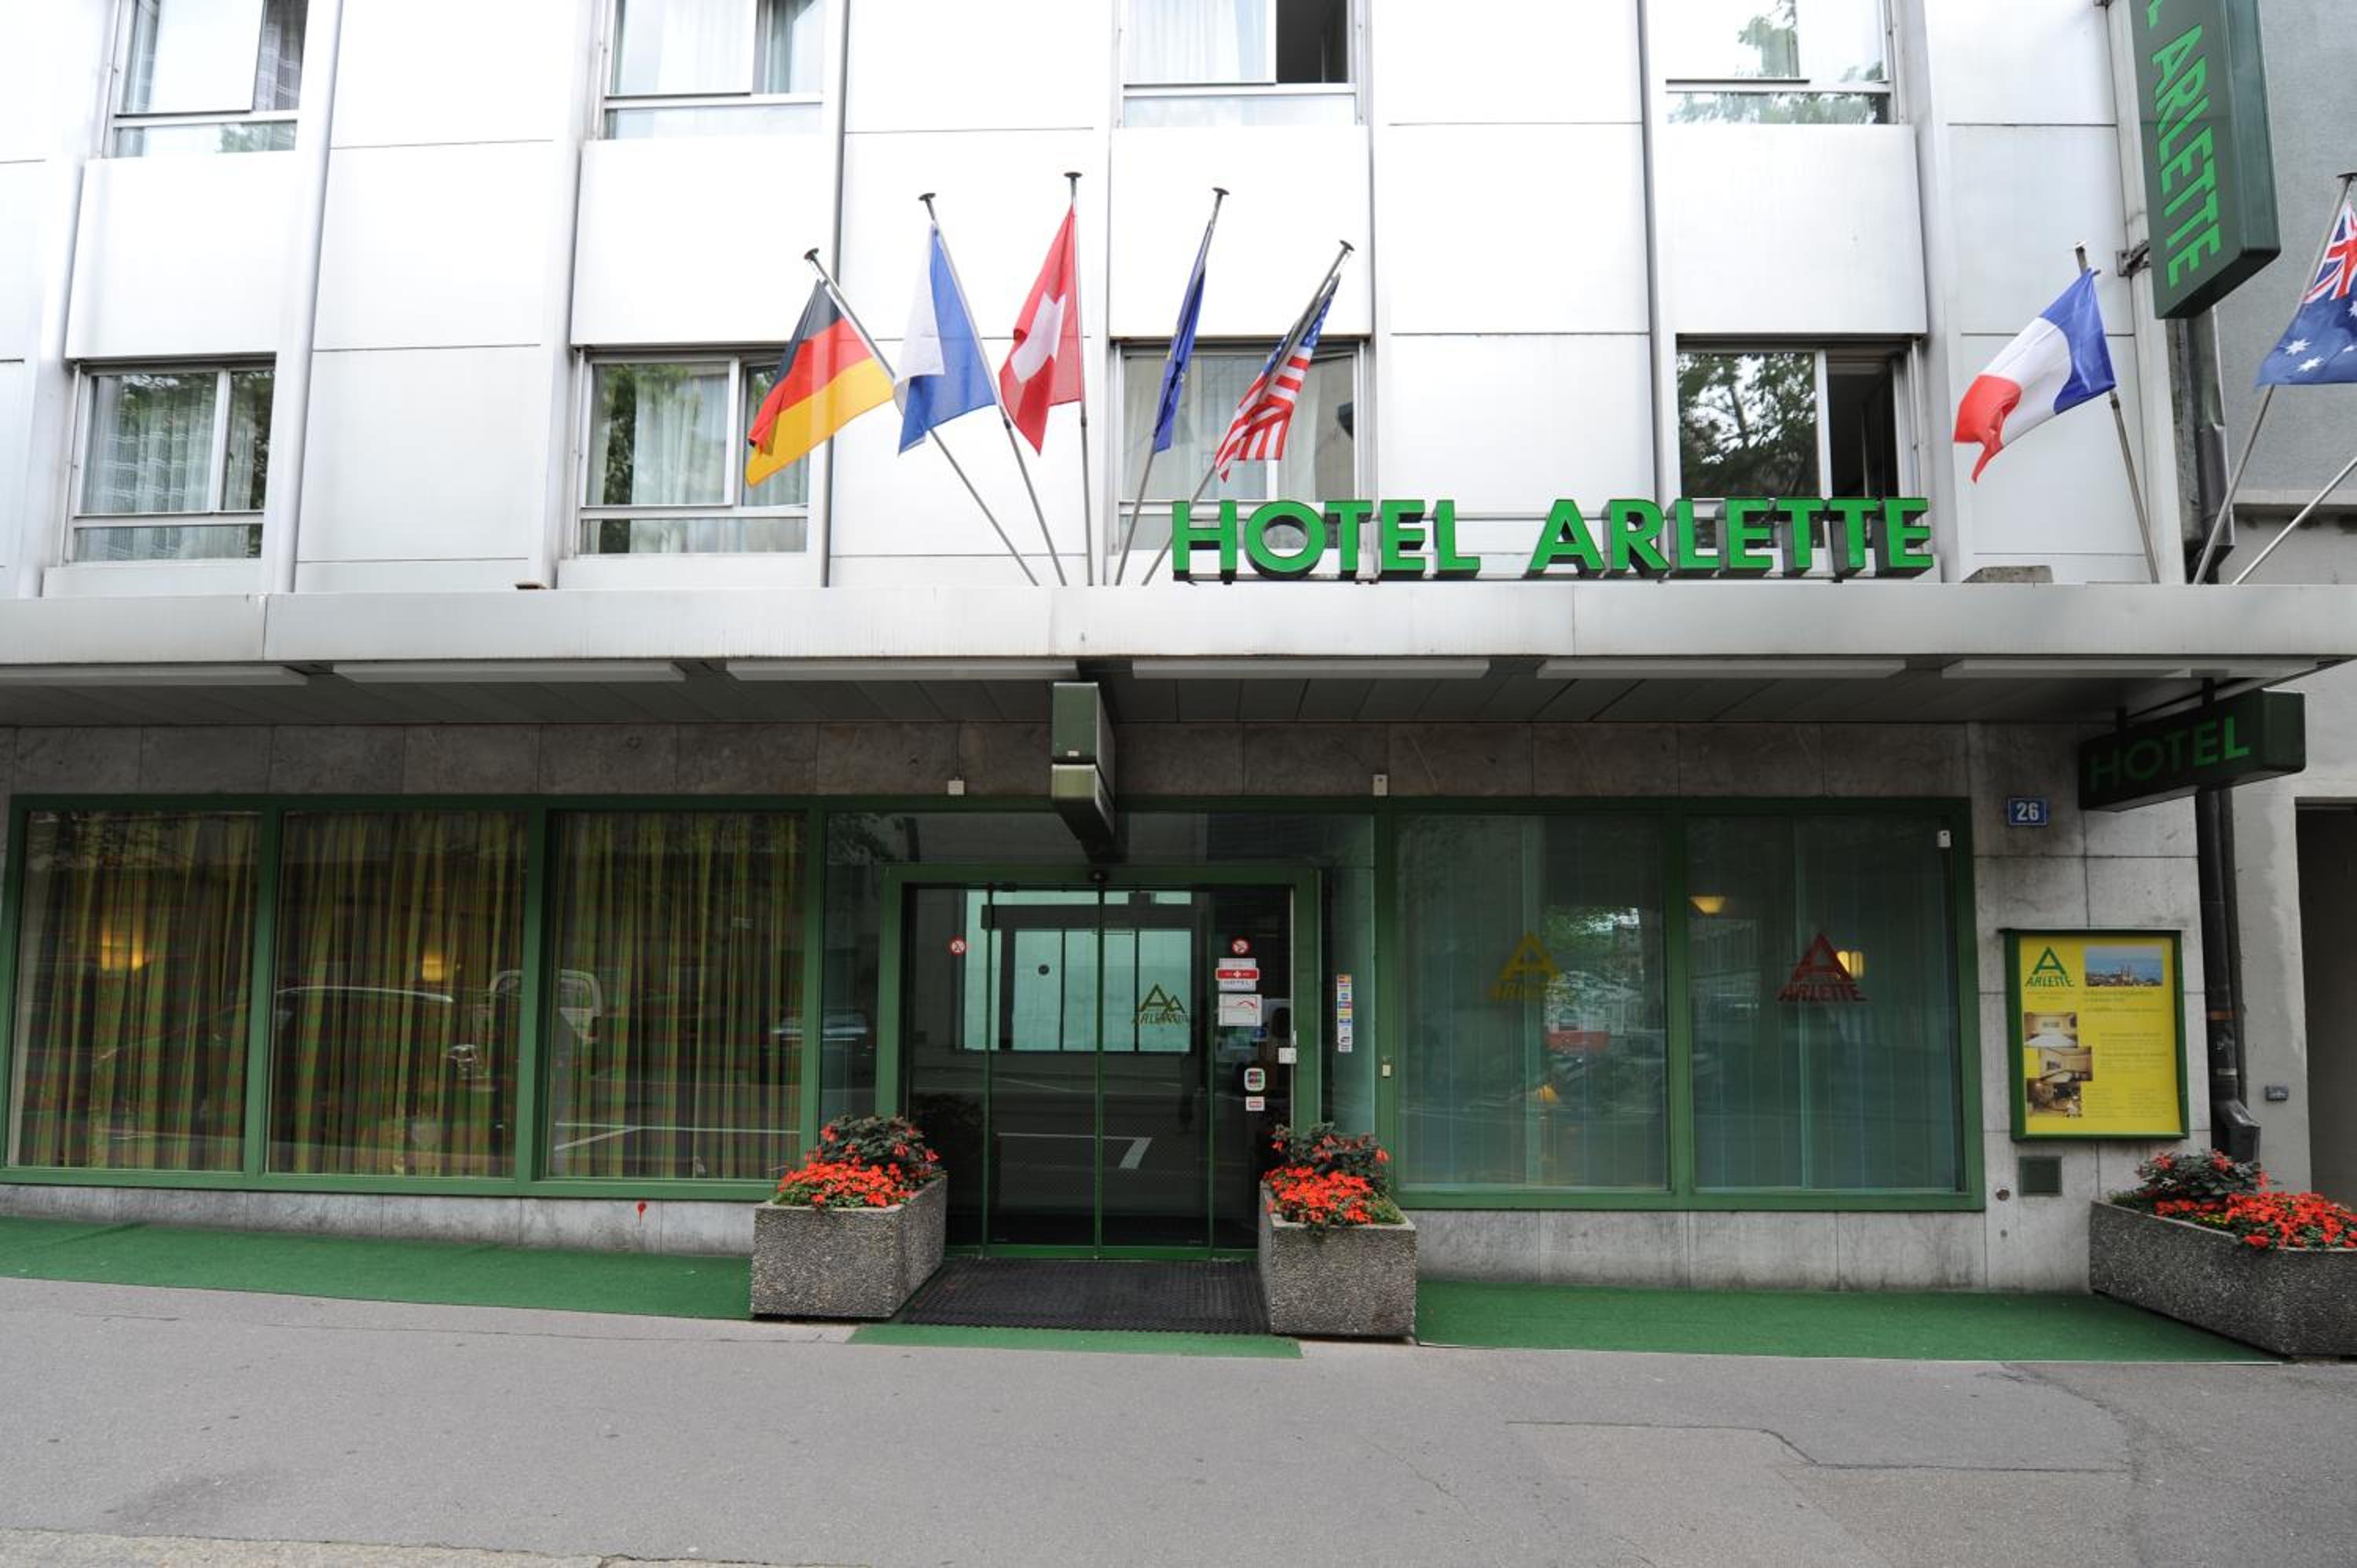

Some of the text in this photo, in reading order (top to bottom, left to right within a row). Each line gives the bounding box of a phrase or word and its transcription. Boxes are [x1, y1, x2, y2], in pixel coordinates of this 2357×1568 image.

[2151, 24, 2221, 289] ARLETTE
[1171, 497, 1934, 577] HOTEL ARLETTE
[2088, 716, 2251, 793] HOTEL
[2016, 801, 2040, 822] 26
[1776, 982, 1869, 1002] ARLETTE
